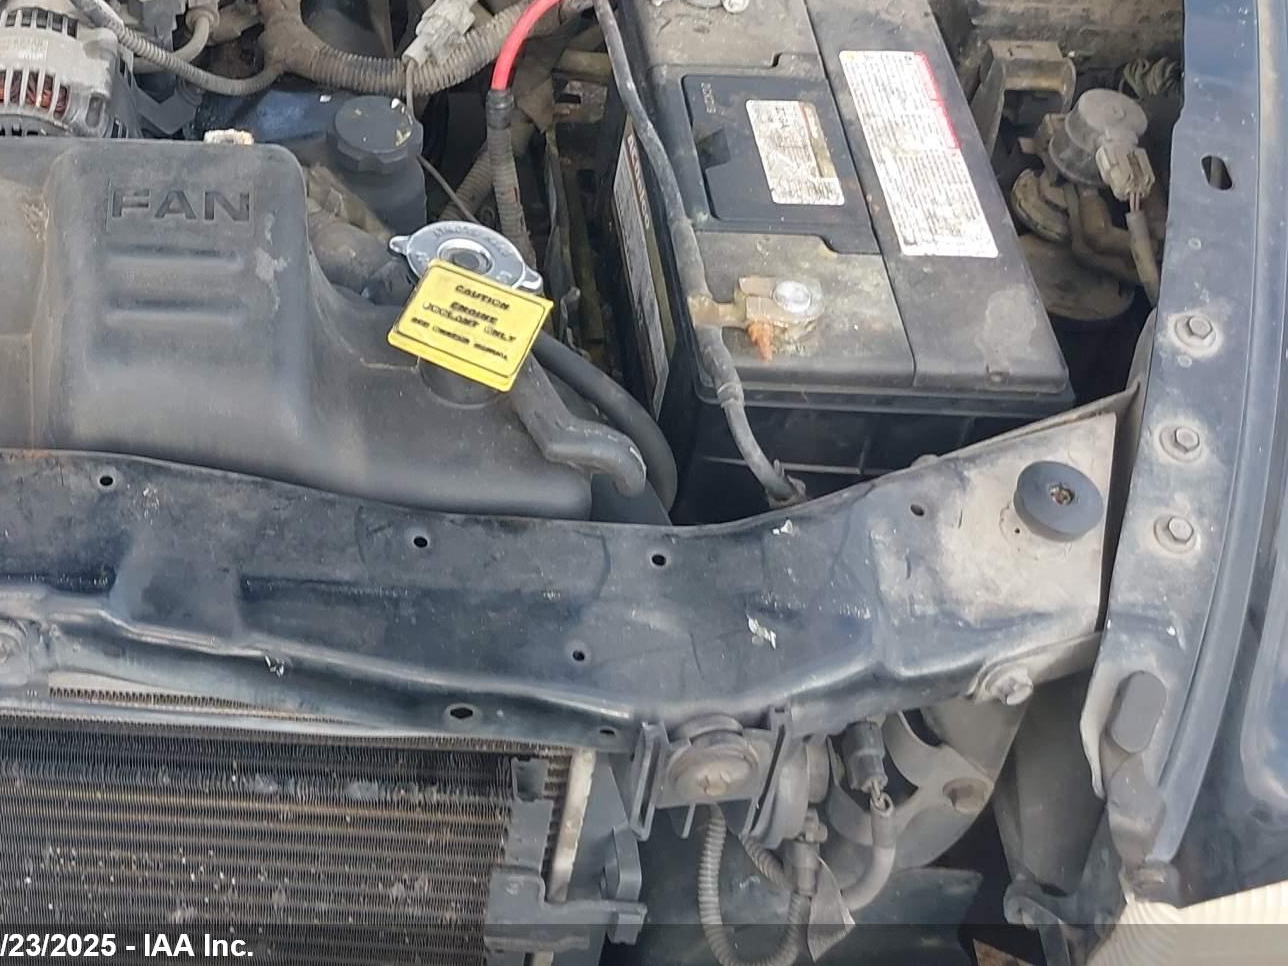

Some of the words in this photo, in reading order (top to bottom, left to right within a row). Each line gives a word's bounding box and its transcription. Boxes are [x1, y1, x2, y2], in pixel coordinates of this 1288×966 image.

[111, 189, 252, 222] FAN
[455, 285, 510, 311] CAUTION
[449, 301, 499, 324] ENGINE
[483, 324, 517, 342] ONLY
